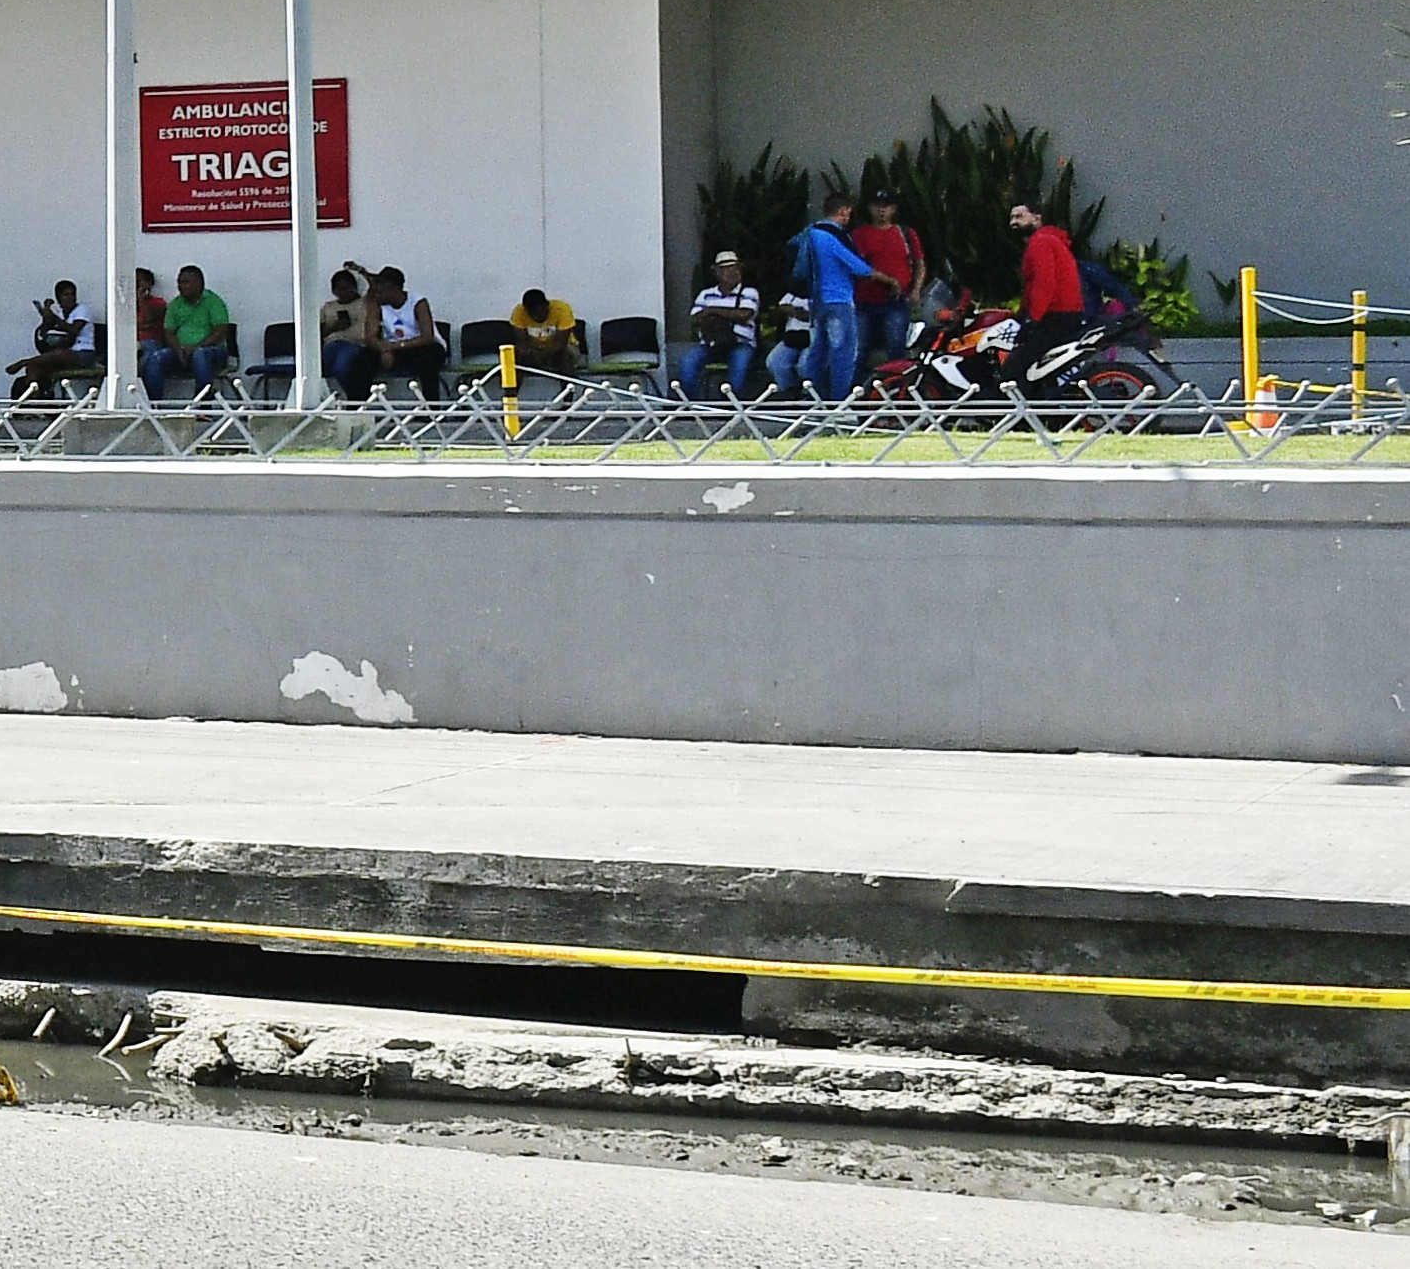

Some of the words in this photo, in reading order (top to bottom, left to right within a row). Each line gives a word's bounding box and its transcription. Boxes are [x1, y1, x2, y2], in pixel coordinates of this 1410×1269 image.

[171, 101, 289, 120] AMBULANCI
[159, 125, 222, 140] ESTRICTO
[224, 122, 288, 137] PROTOCO
[171, 150, 289, 181] TRIAG
[261, 186, 272, 195] de
[274, 185, 290, 195] 201
[163, 202, 205, 212] Ministerio
[207, 201, 219, 211] de
[220, 200, 244, 210] Salud
[253, 199, 290, 209] Protecci
